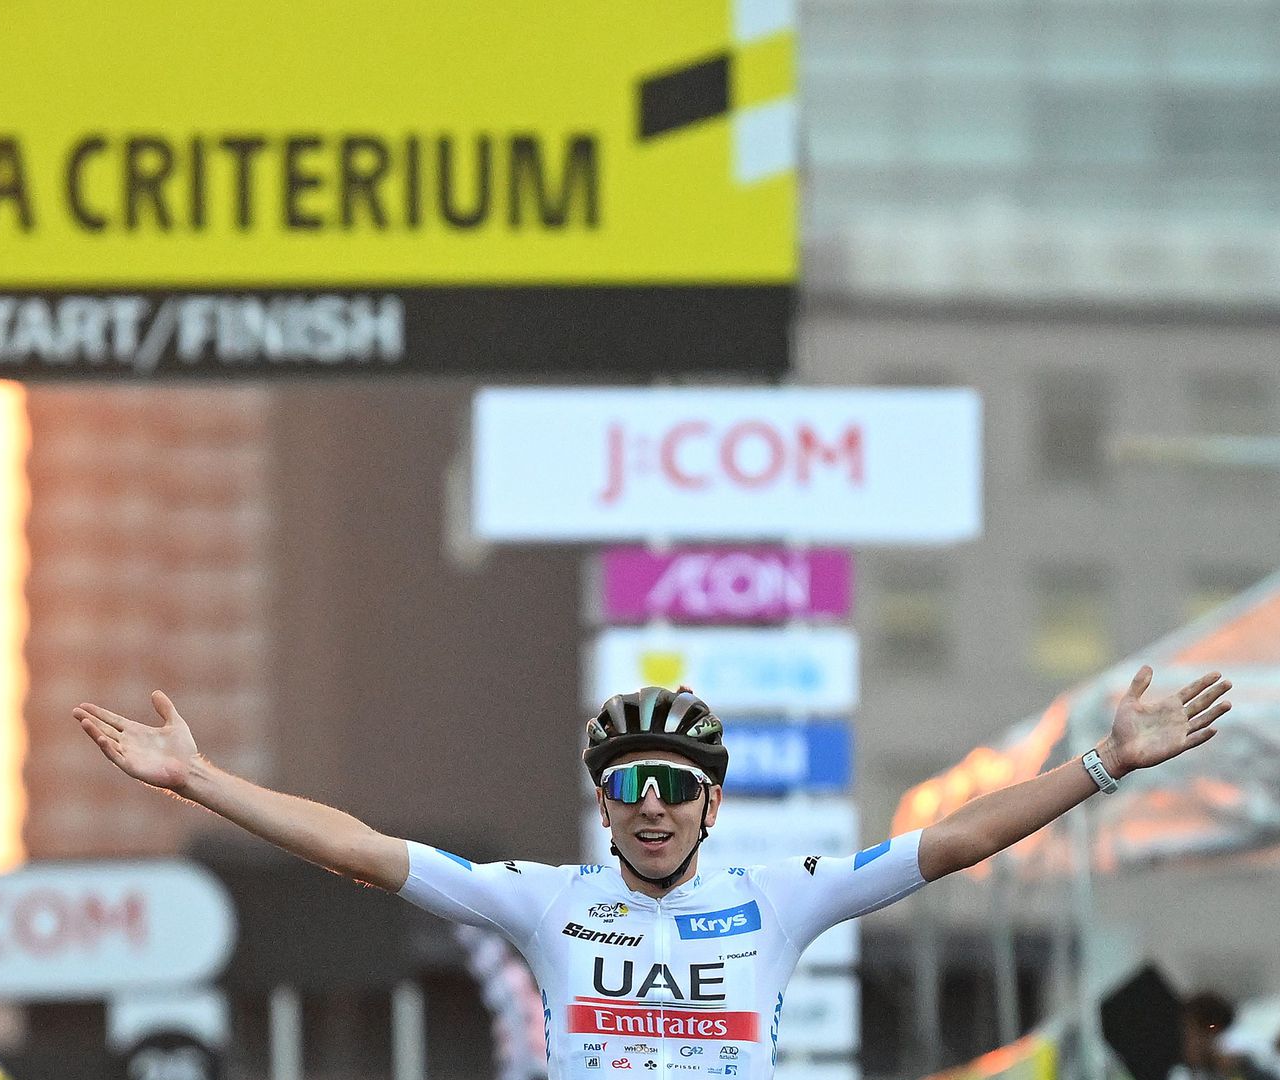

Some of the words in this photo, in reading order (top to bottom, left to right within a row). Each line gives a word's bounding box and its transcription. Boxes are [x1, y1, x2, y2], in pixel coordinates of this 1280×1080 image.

[64, 131, 603, 234] CRITERIUM
[562, 922, 644, 947] Santini
[690, 914, 747, 933] Krys
[593, 957, 726, 1001] UAE
[594, 1009, 728, 1036] Emirates
